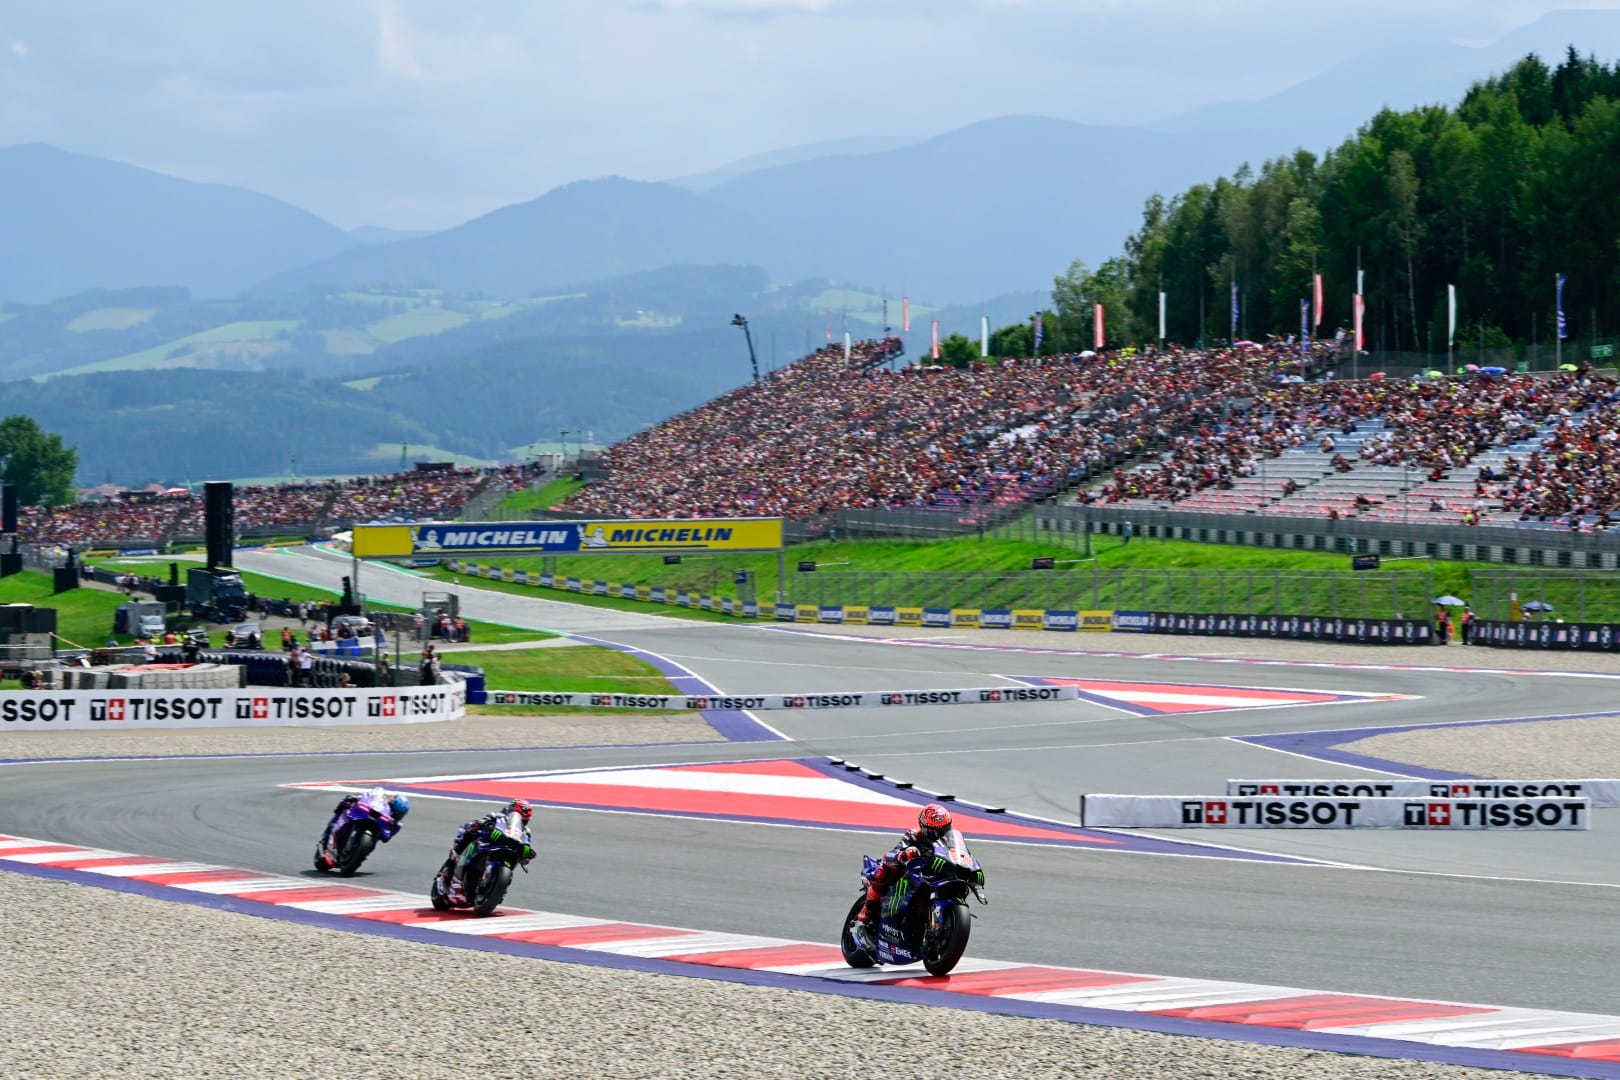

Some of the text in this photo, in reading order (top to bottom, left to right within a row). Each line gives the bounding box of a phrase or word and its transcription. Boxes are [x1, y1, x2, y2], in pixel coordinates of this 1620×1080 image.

[443, 530, 568, 546] MICHELIN
[611, 528, 733, 542] MICHELIN
[518, 694, 573, 705] TISSOT
[806, 695, 862, 707] TISSOT
[905, 692, 960, 703] TISSOT
[1003, 689, 1060, 701] TISSOT
[272, 696, 357, 718] TISSOT
[400, 693, 446, 715] TISSOT
[614, 696, 669, 708] TISSOT
[709, 698, 765, 709] TISSOT
[129, 698, 222, 720] TISSOT
[1283, 785, 1393, 797] TISSOT
[1474, 785, 1582, 798] TISSOT
[1232, 802, 1360, 825] TISSOT
[1456, 803, 1585, 826] TISSOT
